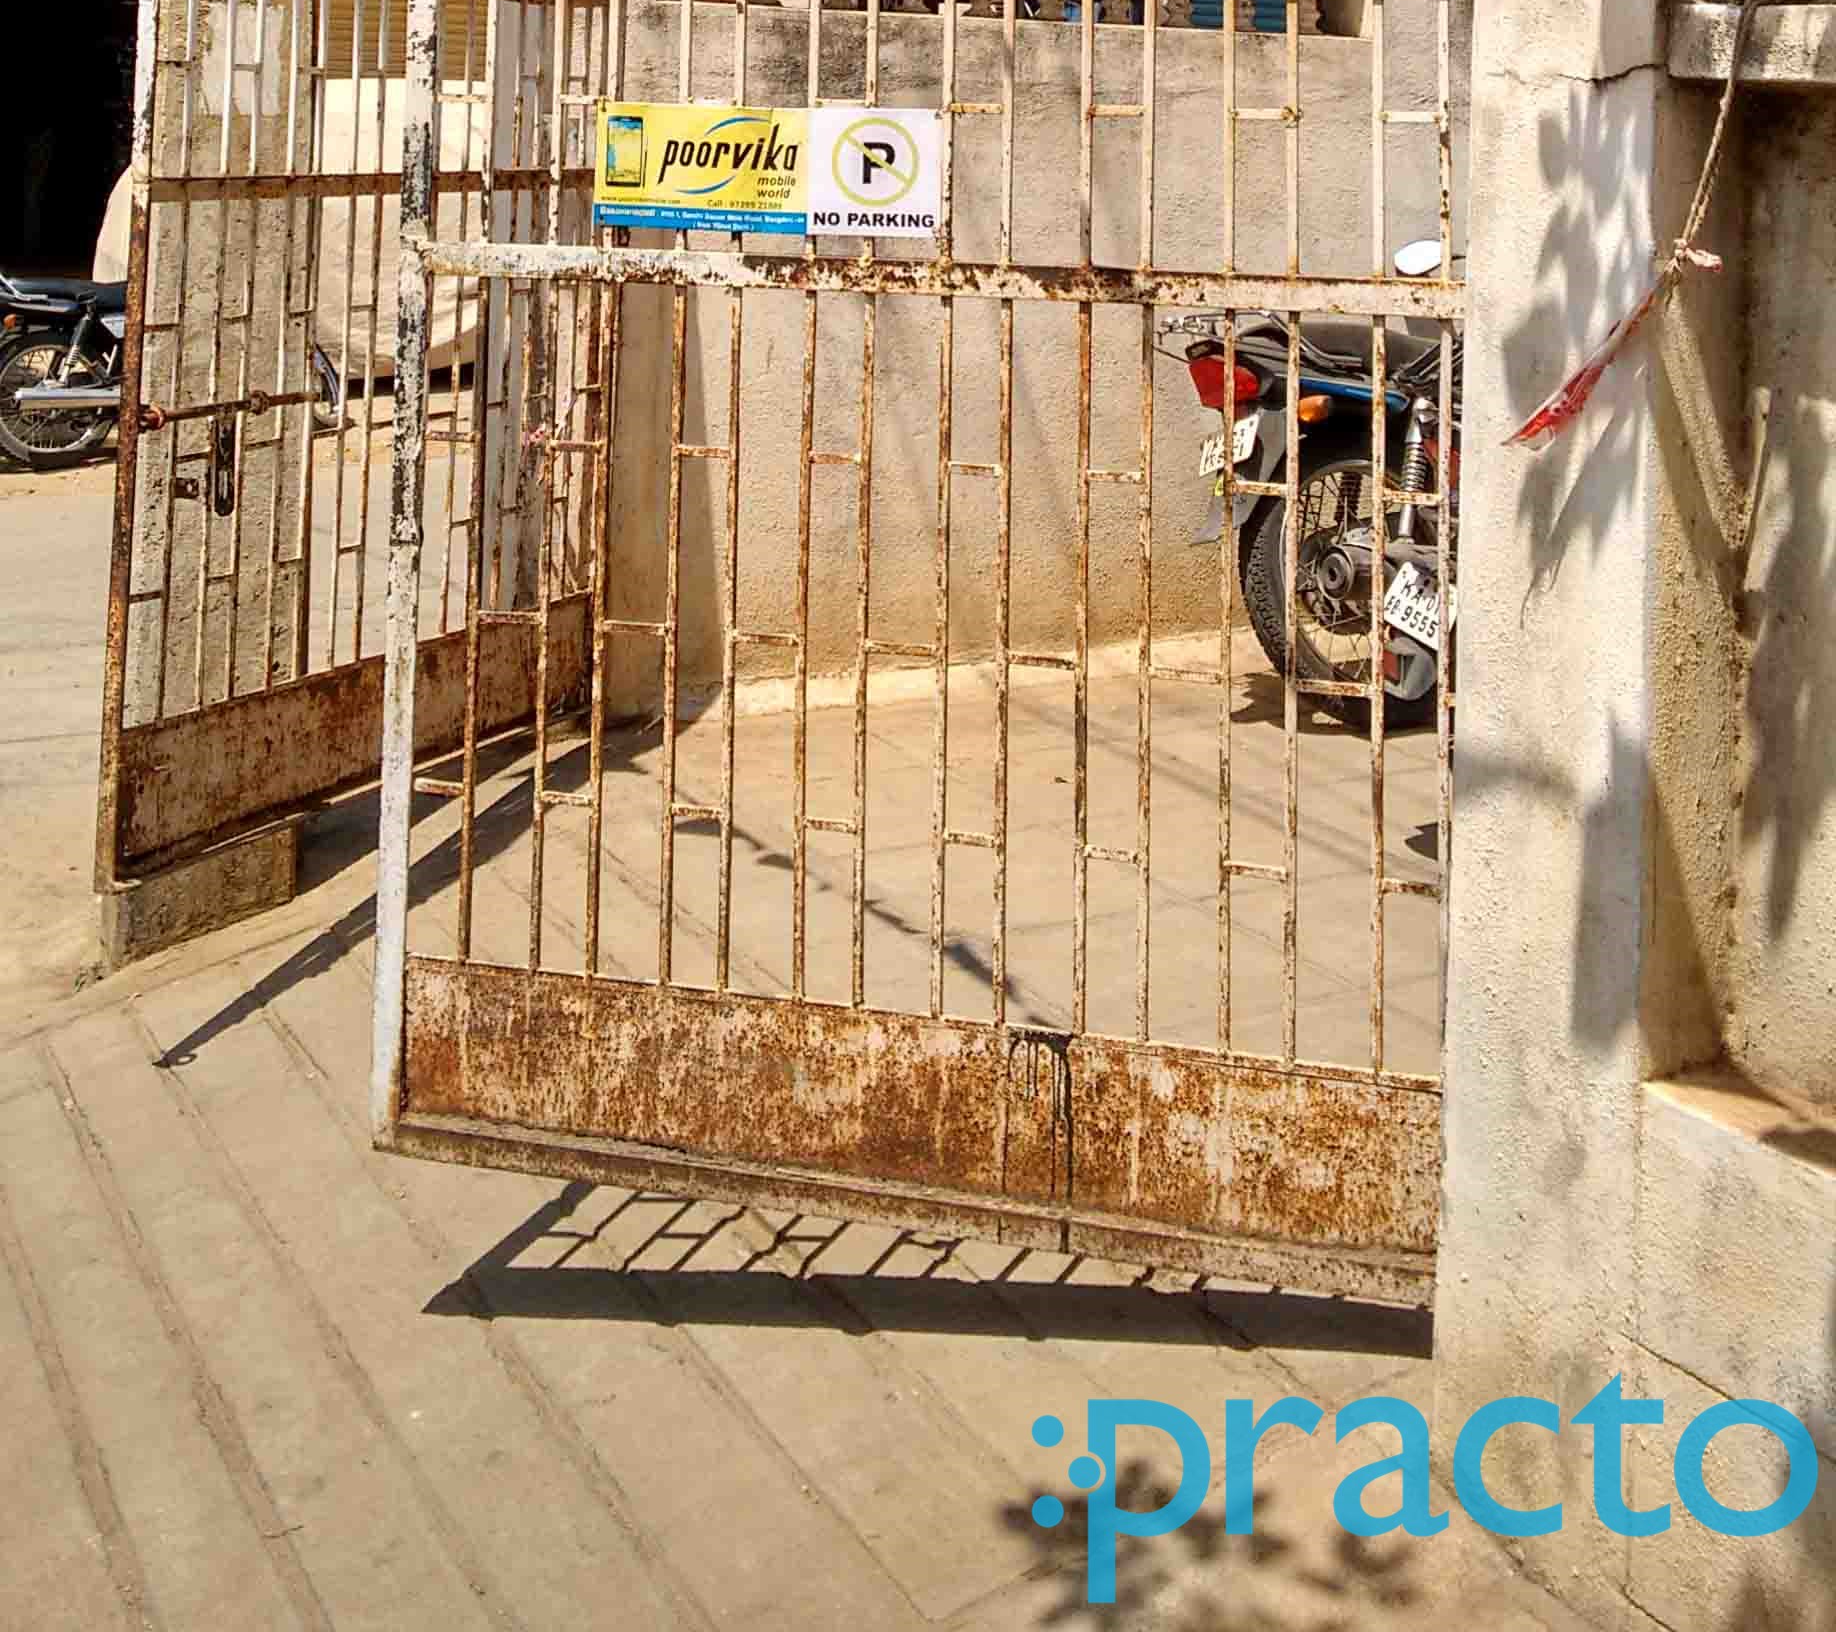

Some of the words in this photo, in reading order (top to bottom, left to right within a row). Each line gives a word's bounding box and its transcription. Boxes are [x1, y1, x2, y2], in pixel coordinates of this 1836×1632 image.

[657, 123, 800, 185] poorvika
[862, 141, 896, 185] P
[756, 174, 797, 187] mobile
[756, 187, 791, 200] world
[812, 211, 840, 228] NO
[846, 212, 935, 229] PARKING
[1401, 605, 1441, 639] 9555
